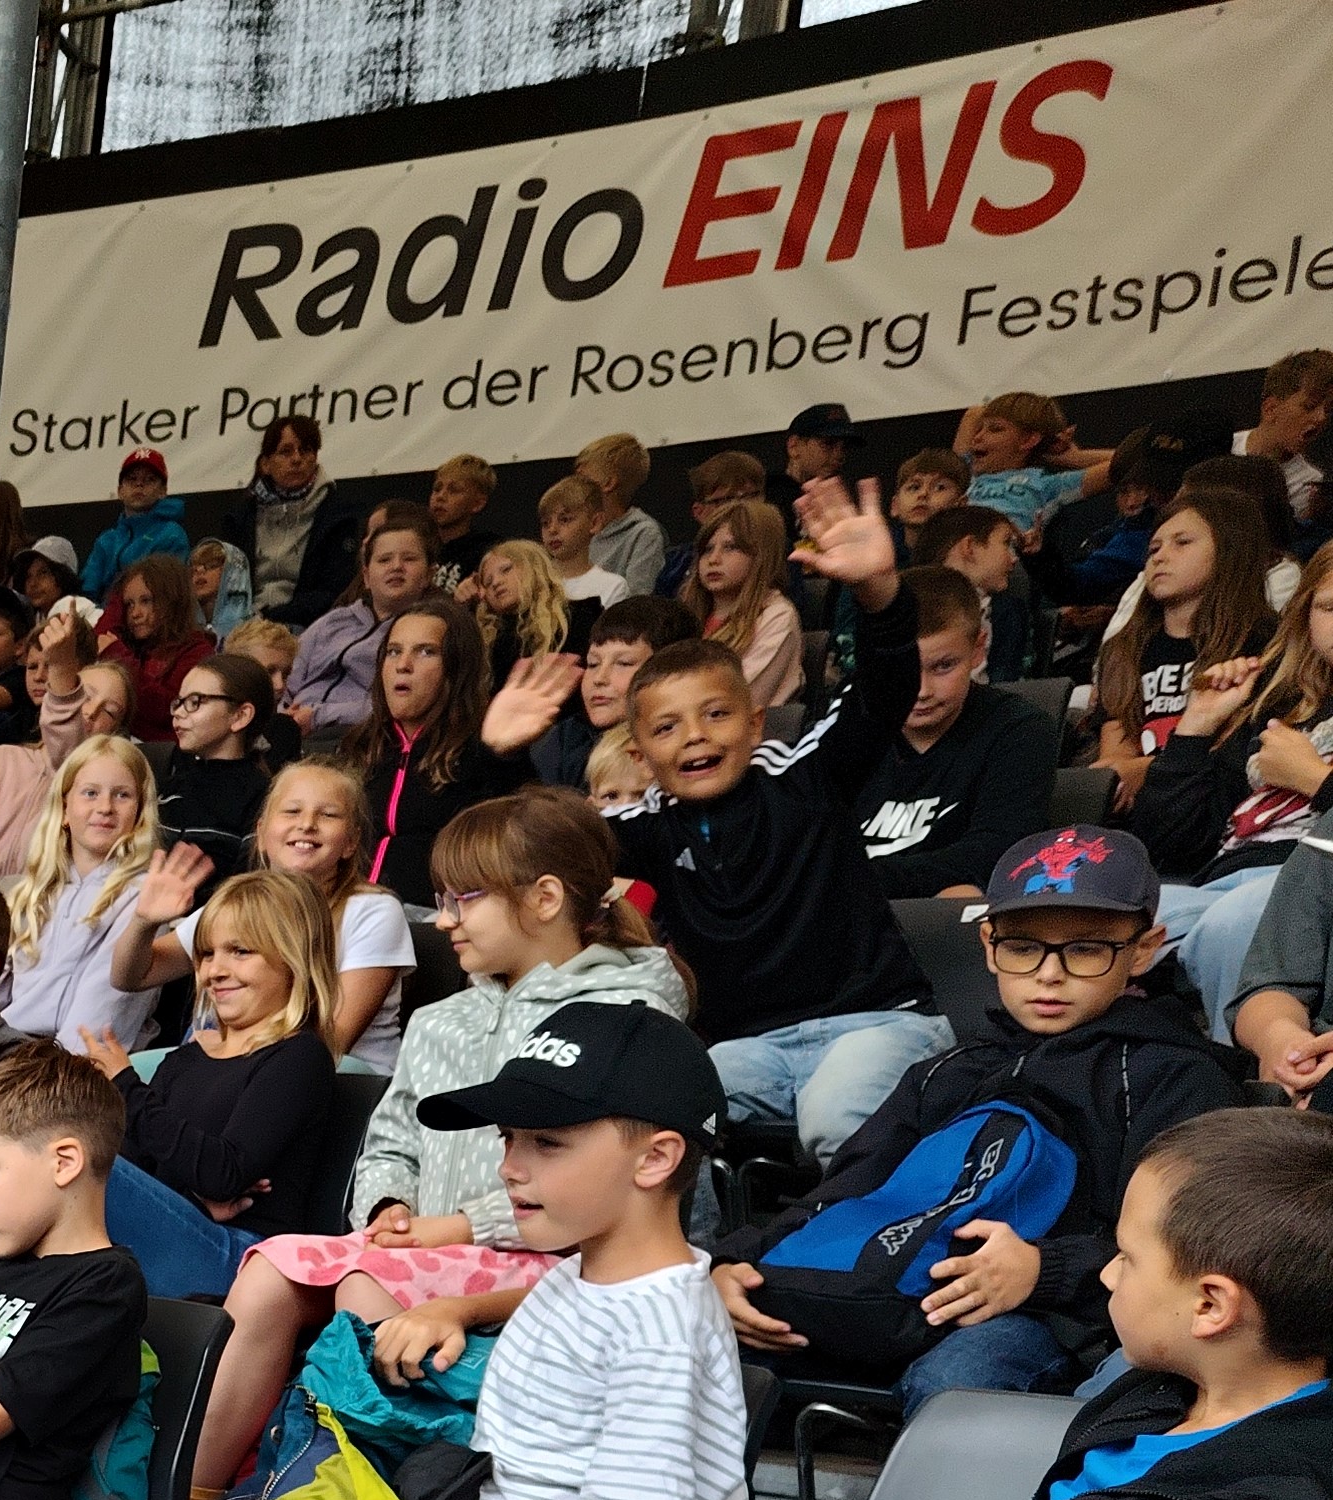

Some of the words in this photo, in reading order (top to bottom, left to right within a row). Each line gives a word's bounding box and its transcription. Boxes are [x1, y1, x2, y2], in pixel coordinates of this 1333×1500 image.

[197, 177, 646, 349] Radio
[662, 58, 1115, 288] EINS
[8, 399, 200, 458] Starker
[218, 377, 423, 437] Partner
[442, 359, 549, 411] der
[571, 310, 931, 399] Rosenberg
[957, 235, 1333, 347] Festspiele
[863, 796, 941, 839] NIKE
